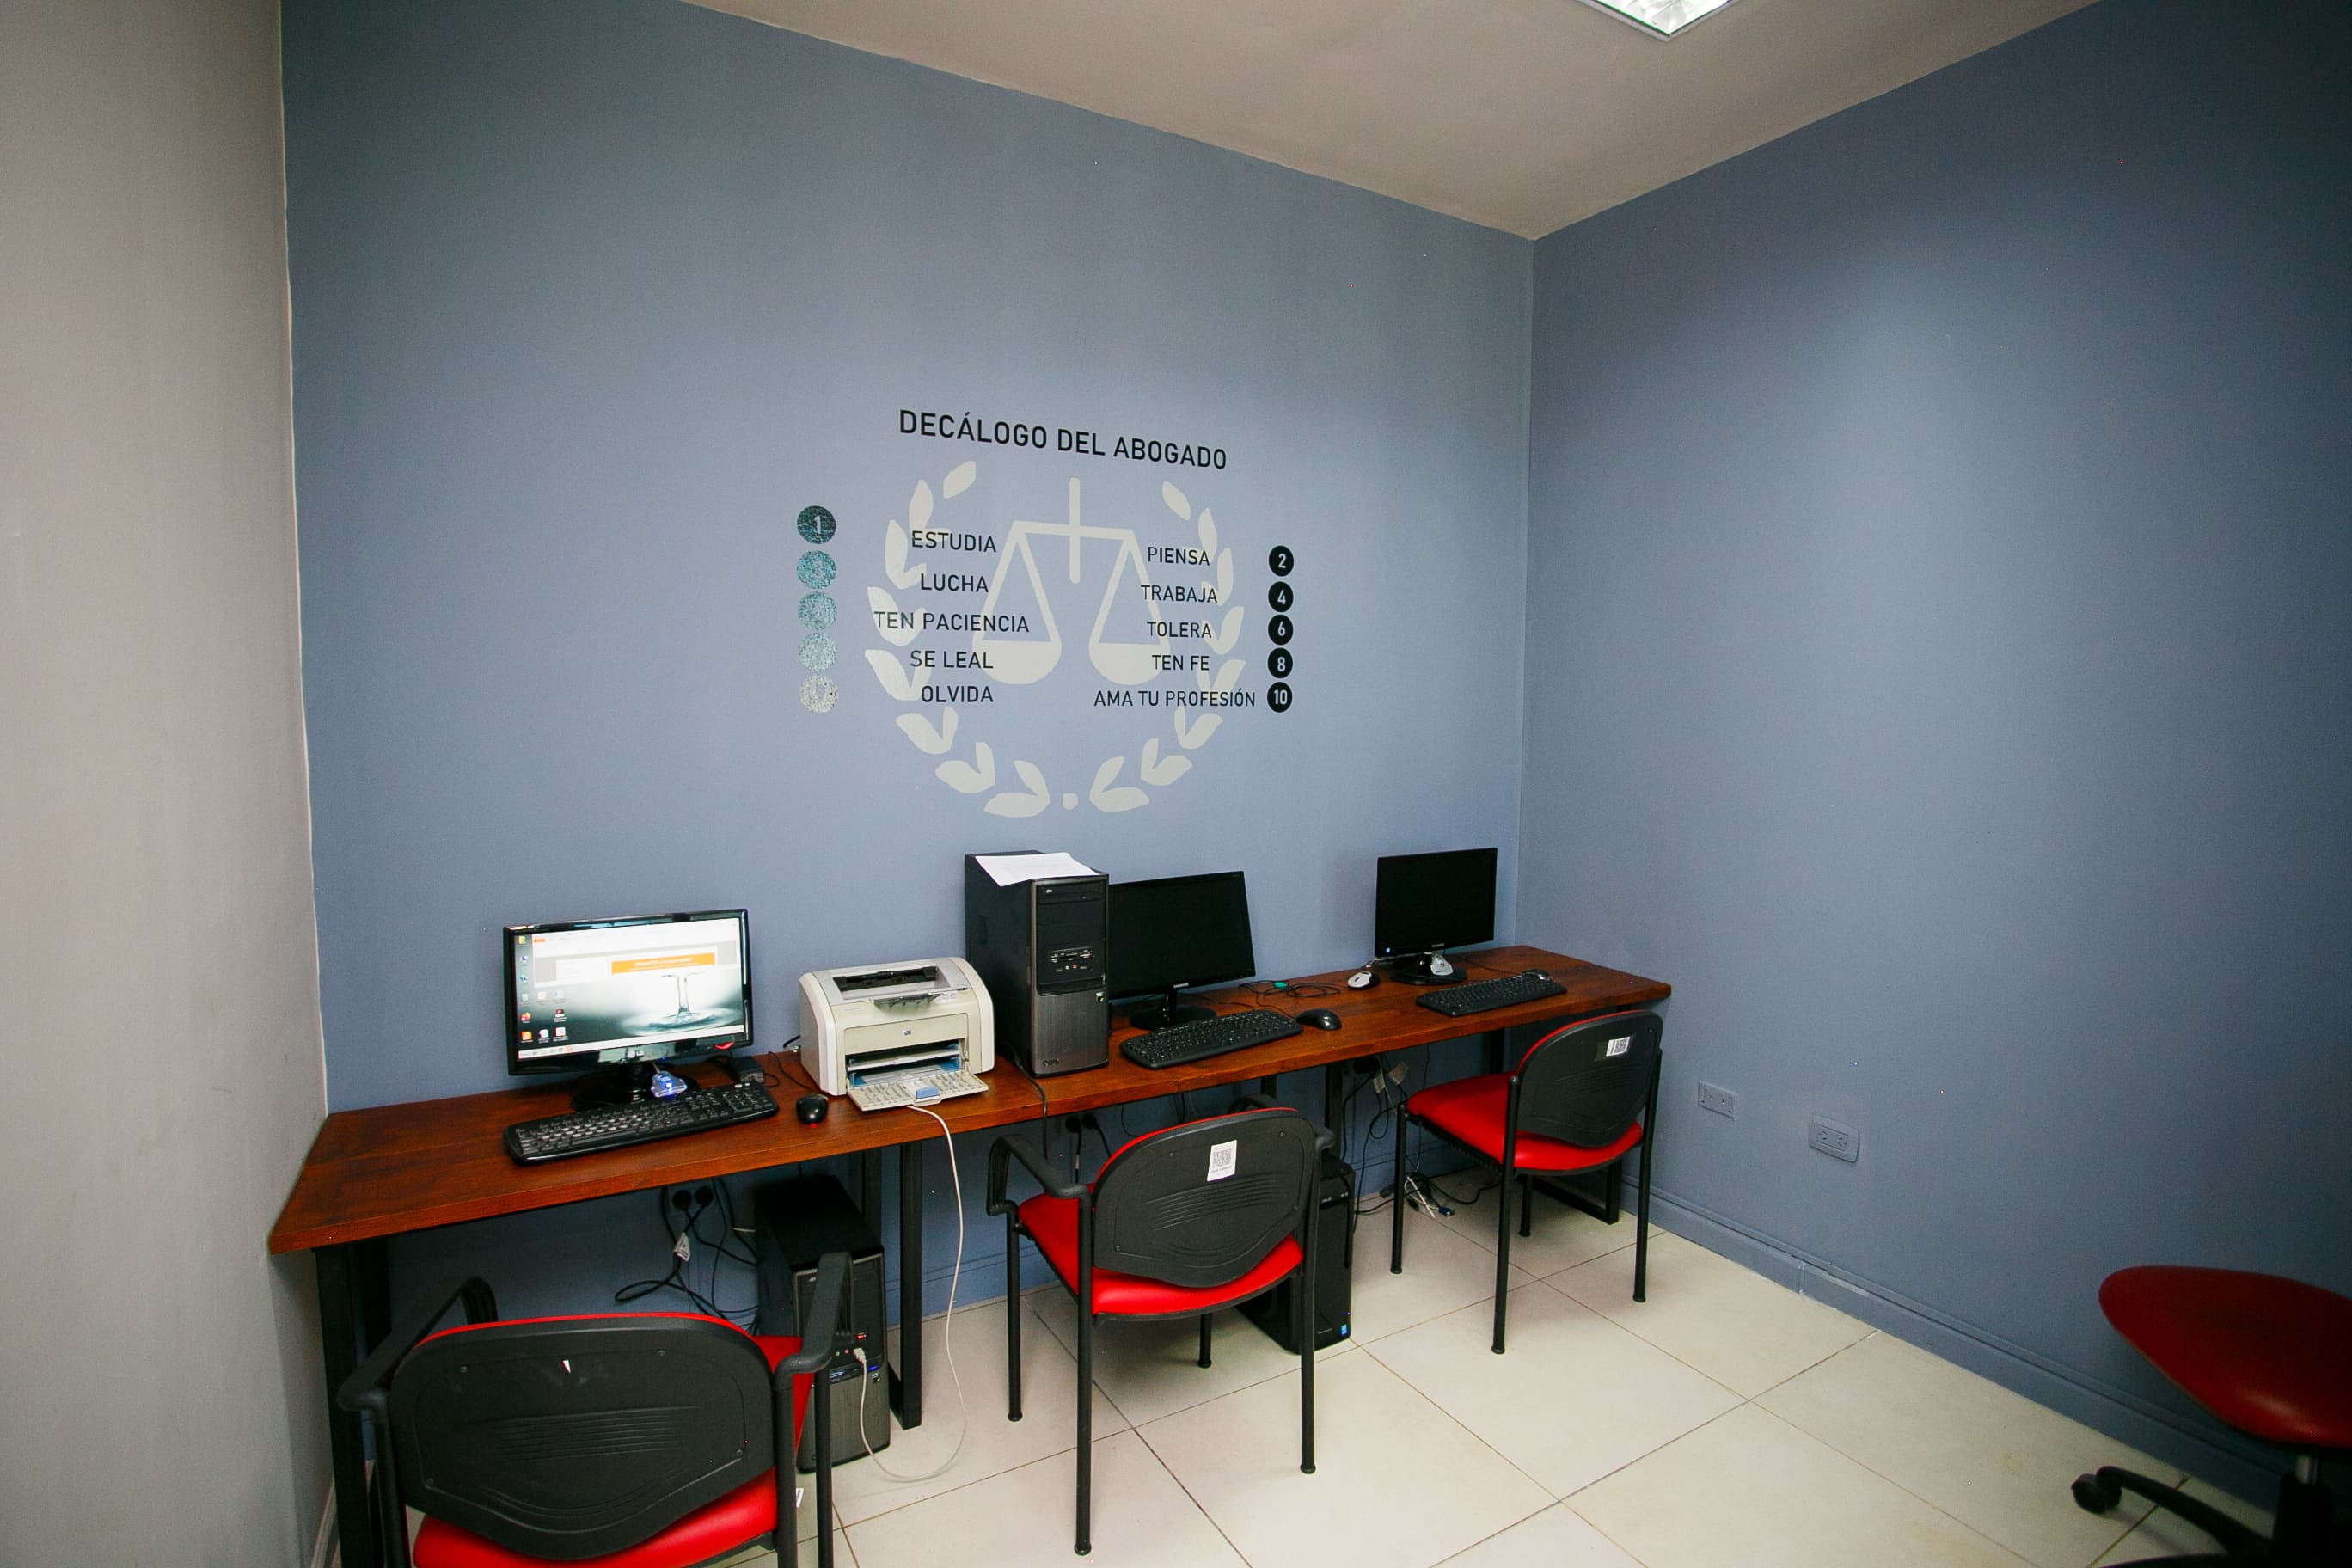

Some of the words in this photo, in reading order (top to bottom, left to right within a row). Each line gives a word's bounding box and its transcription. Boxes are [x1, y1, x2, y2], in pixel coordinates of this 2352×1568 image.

[899, 409, 1047, 449] DECÁLOGO
[1057, 428, 1106, 456] DEL
[1112, 436, 1227, 470] ABOGADO
[814, 515, 822, 535] 1
[911, 530, 997, 553] ESTUDIA
[1148, 546, 1210, 567] PIENSA
[1277, 553, 1287, 569] 2
[921, 572, 989, 593] LUCHA
[1140, 584, 1218, 603] TRABAJA
[1277, 590, 1287, 605] 4
[873, 610, 914, 629] TEN
[923, 612, 1030, 633] PACIENCIA
[1146, 621, 1212, 639] TOLERA
[1277, 621, 1286, 636] 6
[910, 650, 936, 668] SE
[943, 651, 994, 669] LEAL
[1151, 654, 1184, 671] TEN
[1190, 655, 1210, 671] FE
[1277, 657, 1286, 672] 8
[921, 685, 994, 703] OLVIDA
[1093, 690, 1134, 707] AMA
[1137, 690, 1159, 707] TU
[1165, 689, 1255, 707] PROFESIÓN
[1273, 689, 1288, 705] 10
